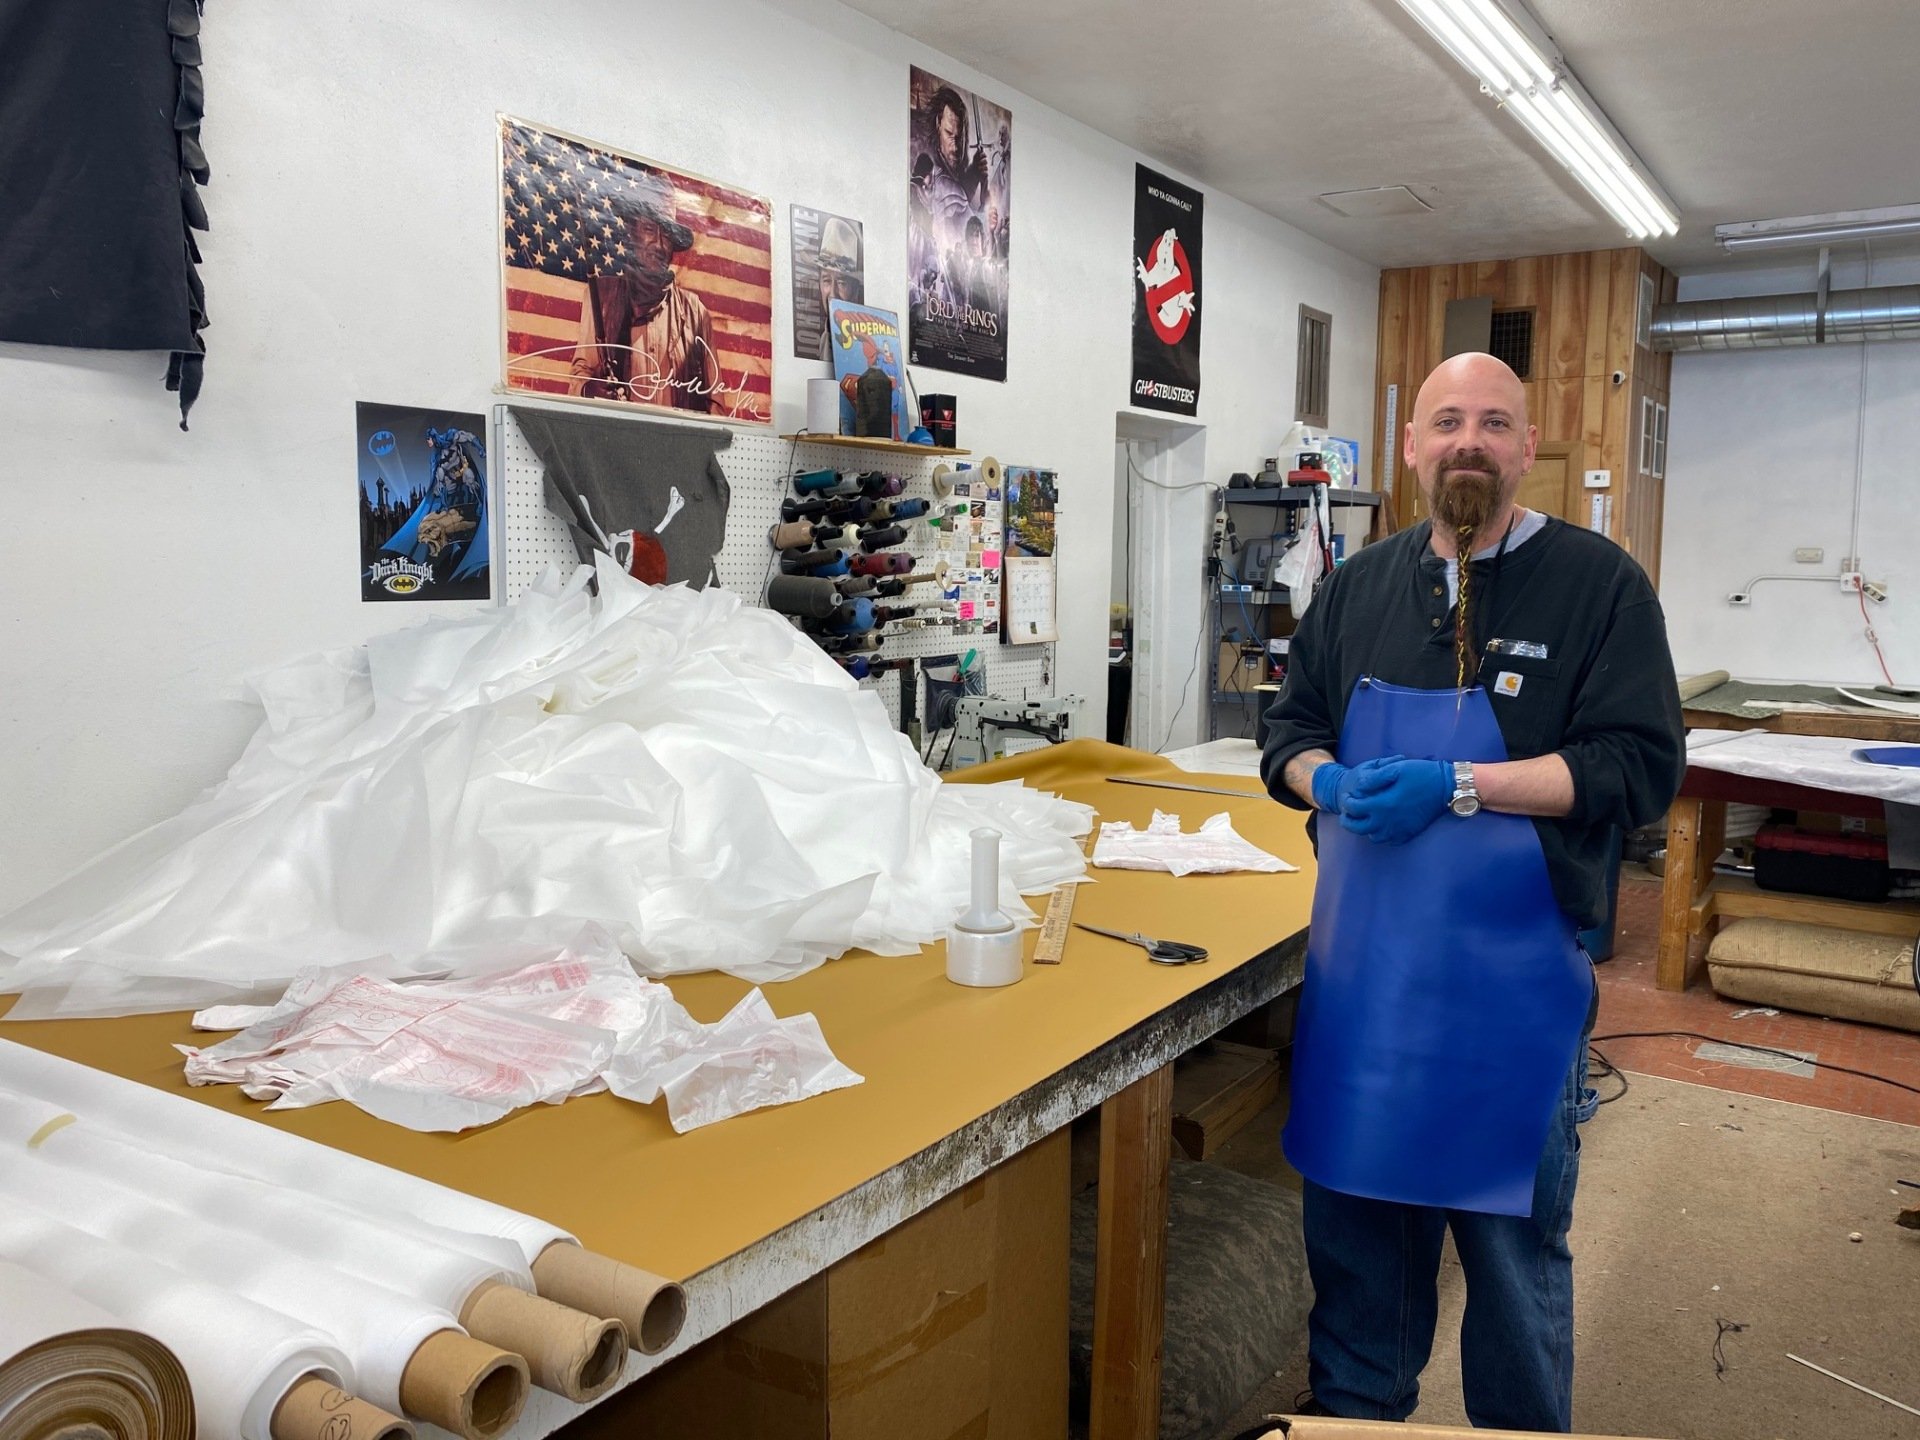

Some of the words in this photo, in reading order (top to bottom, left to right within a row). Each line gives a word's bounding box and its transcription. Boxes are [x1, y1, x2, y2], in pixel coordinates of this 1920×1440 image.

[794, 208, 820, 290] WAYNE
[925, 292, 956, 322] LORD
[963, 303, 997, 337] RINGS
[796, 296, 822, 354] JOHN
[841, 319, 897, 350] SUPERMAN
[368, 559, 398, 585] Dark
[396, 556, 436, 584] Knight
